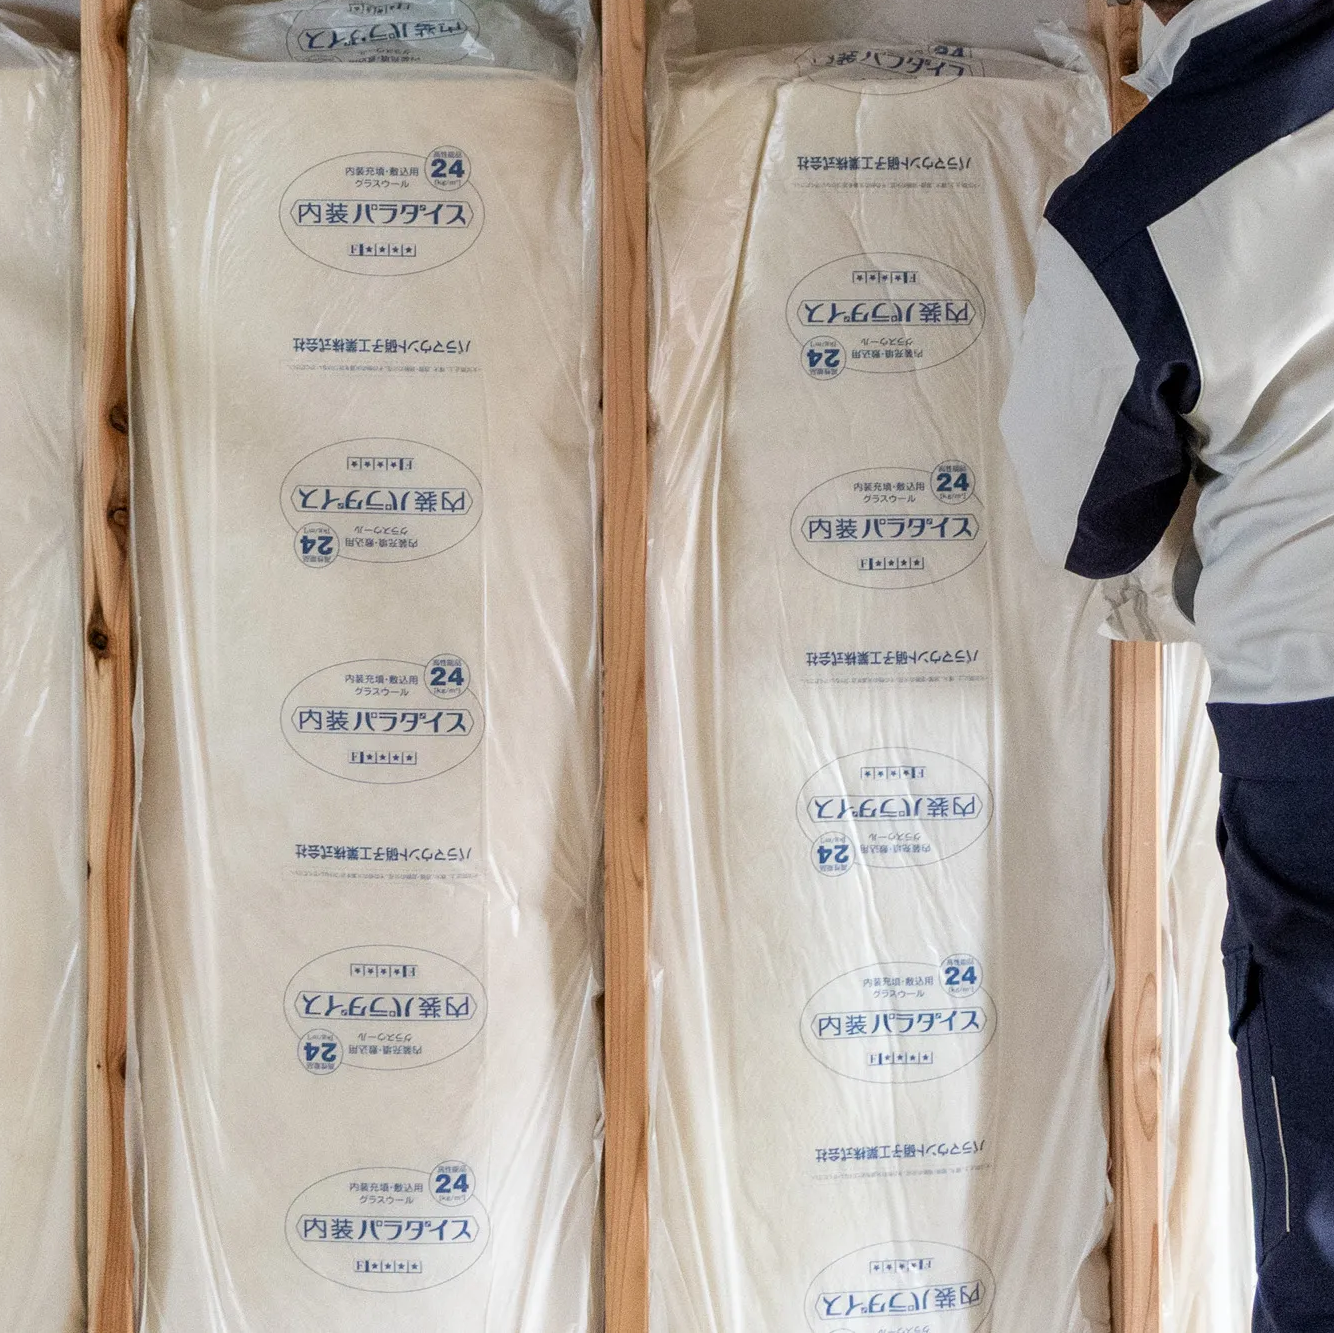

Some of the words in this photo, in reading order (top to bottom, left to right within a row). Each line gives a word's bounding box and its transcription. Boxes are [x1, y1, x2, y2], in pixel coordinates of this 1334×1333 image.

[430, 159, 466, 179] 24
[298, 204, 467, 225] 内装パラダイス
[804, 302, 969, 324] 内装パラダイス
[806, 349, 840, 368] 24
[936, 473, 969, 492] 24
[299, 487, 465, 512] 内装パラダイス
[808, 518, 972, 539] 内装パラダイス
[299, 535, 334, 556] 24
[430, 667, 464, 686] 24
[299, 710, 466, 733] 内装パラダイス
[814, 796, 975, 820] 内装パラダイス
[817, 844, 850, 864] 24
[944, 966, 977, 986] 24
[303, 994, 469, 1019] 内装パラダイス
[818, 1010, 979, 1036] 内装パラダイス
[303, 1042, 337, 1062] 24
[435, 1174, 469, 1194] 24
[303, 1219, 471, 1240] 内装パラダイス
[821, 1282, 979, 1317] 内装パラダイス
